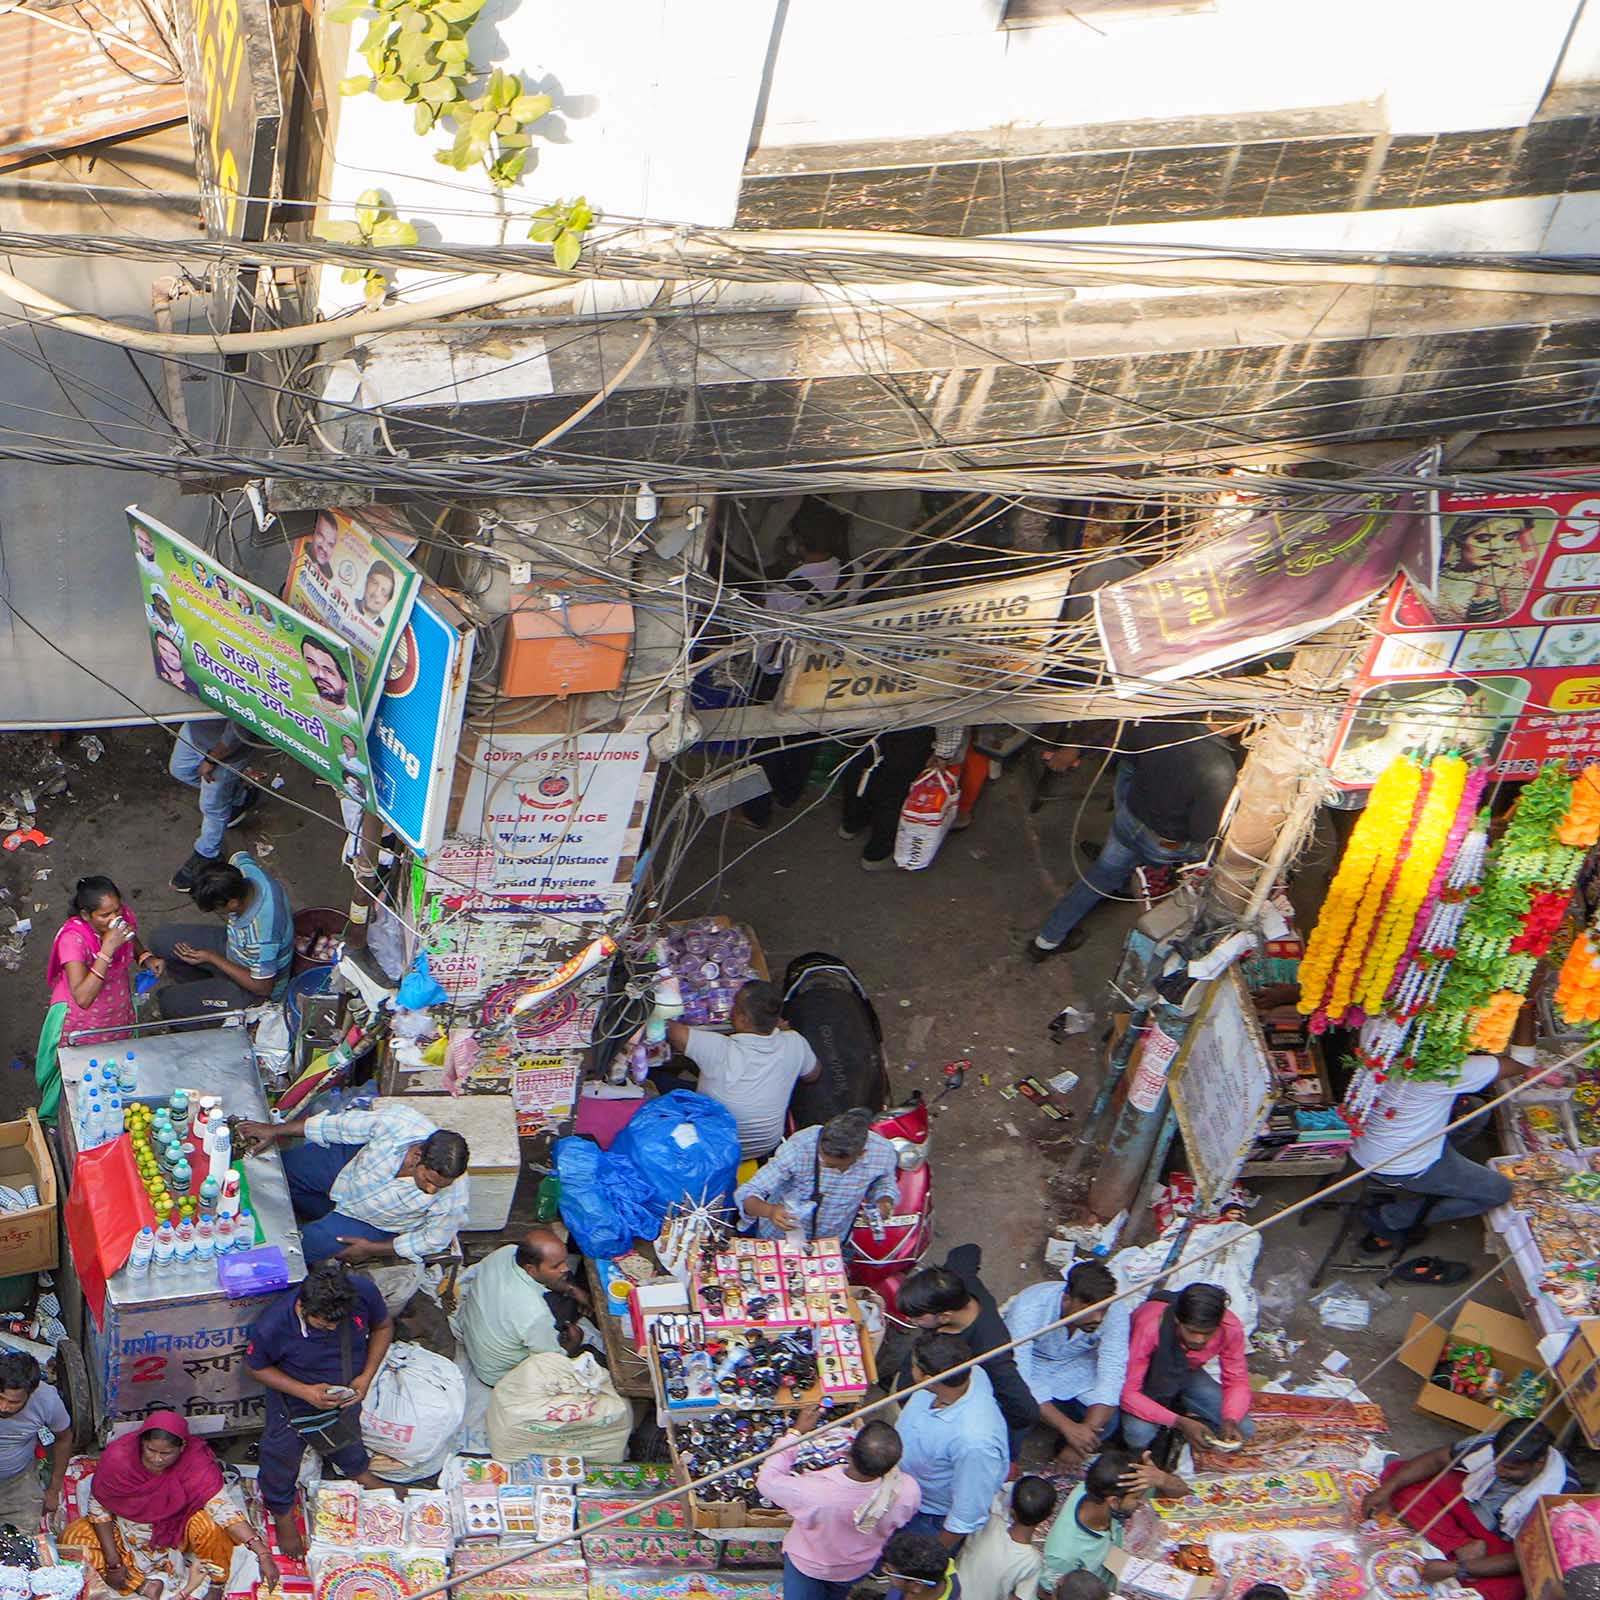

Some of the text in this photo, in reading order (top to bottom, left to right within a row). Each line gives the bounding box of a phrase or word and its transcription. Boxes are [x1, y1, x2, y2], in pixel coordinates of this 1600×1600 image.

[216, 639, 294, 700] जश्ने ईद
[375, 715, 421, 781] king
[556, 854, 610, 866] Distance
[540, 877, 597, 890] Hygiene
[438, 963, 477, 972] LOAN
[131, 1355, 169, 1384] 2
